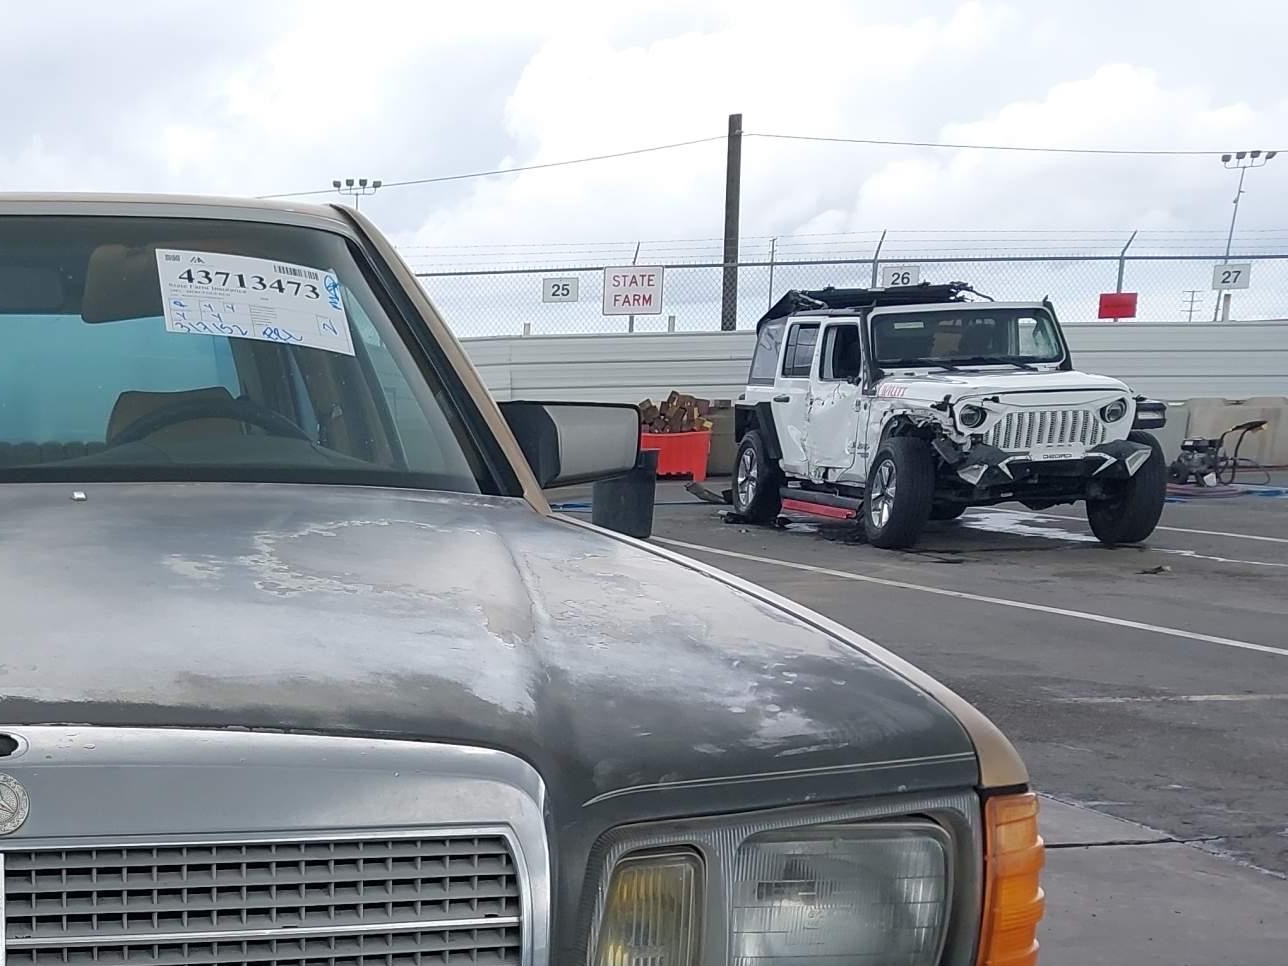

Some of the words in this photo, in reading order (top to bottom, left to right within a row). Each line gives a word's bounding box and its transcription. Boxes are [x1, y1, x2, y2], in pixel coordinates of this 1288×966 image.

[178, 268, 320, 300] 43713473
[612, 274, 655, 287] STATE
[891, 271, 911, 285] 26
[1221, 270, 1241, 284] 27
[551, 283, 570, 297] 25
[613, 294, 652, 307] FARM
